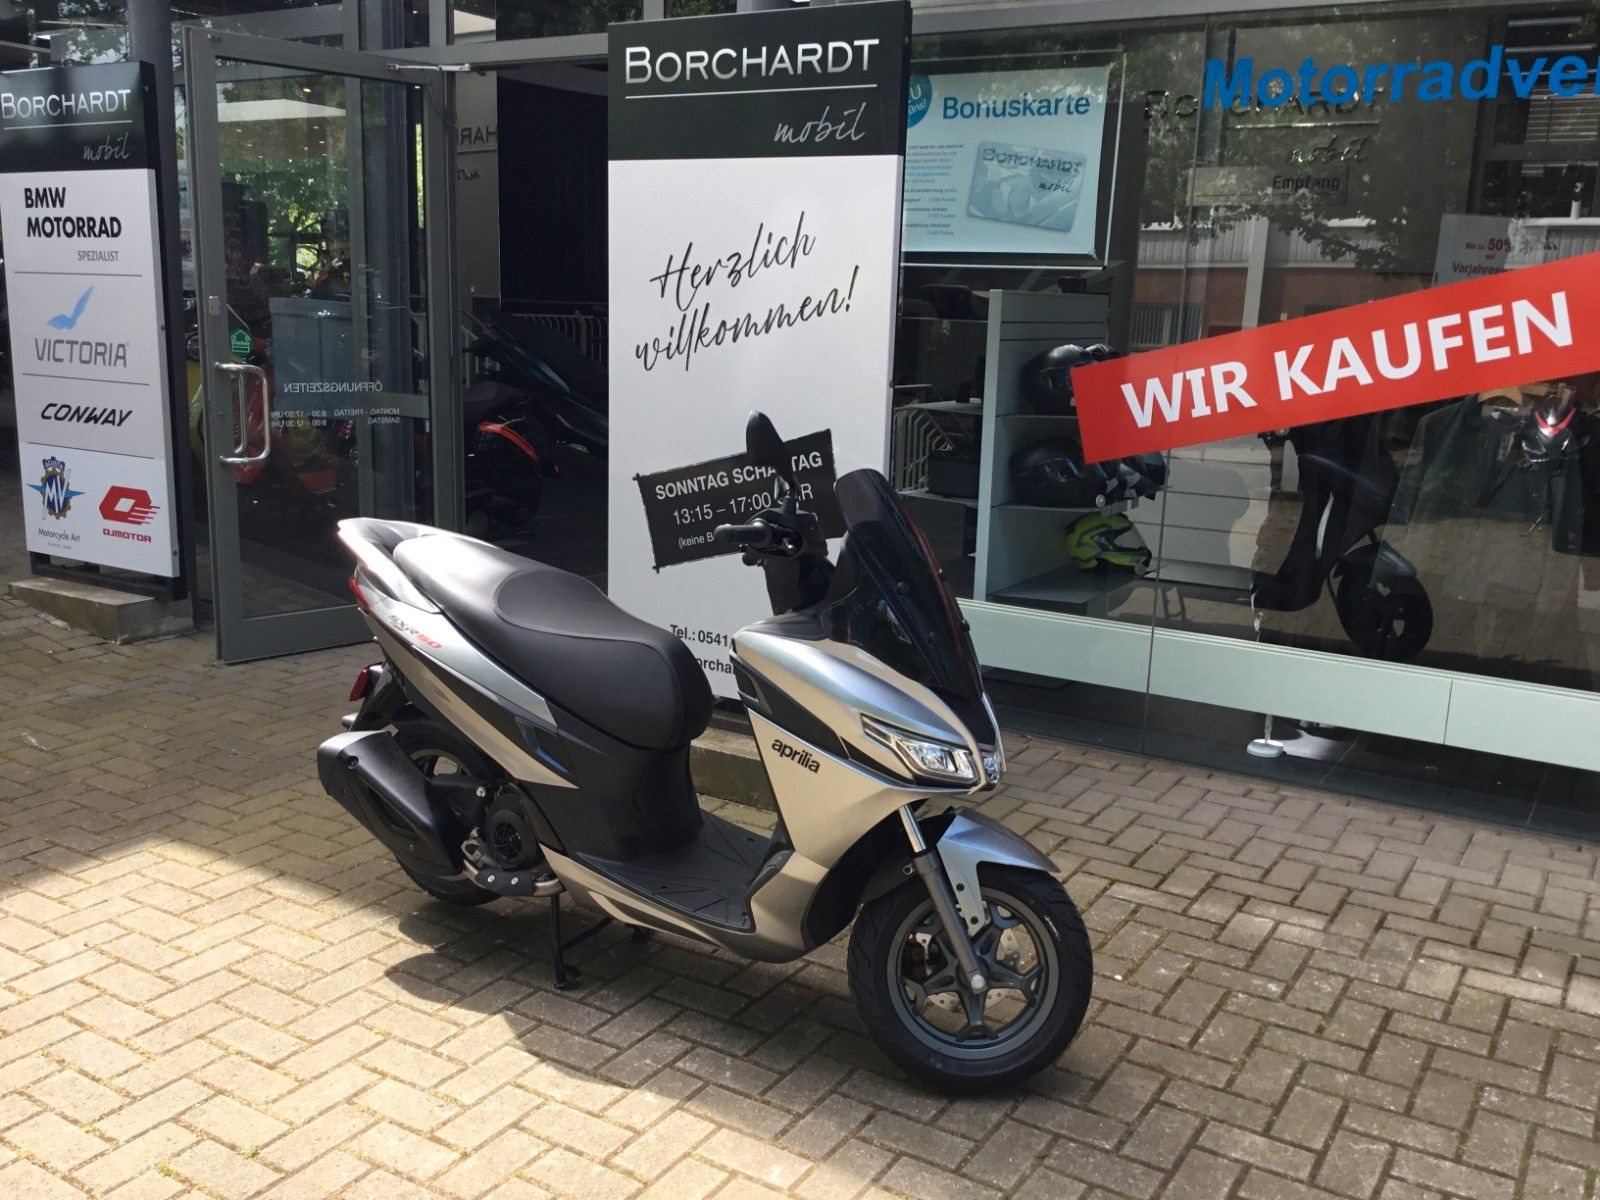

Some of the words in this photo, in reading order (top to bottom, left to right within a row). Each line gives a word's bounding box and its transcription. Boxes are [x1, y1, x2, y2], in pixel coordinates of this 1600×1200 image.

[625, 39, 879, 83] BORCHARDT
[1203, 45, 1600, 109] Motorradve
[1, 89, 131, 119] BORCHARDT
[942, 94, 1091, 119] Bonuskarte
[774, 102, 867, 143] mobil
[83, 132, 130, 161] mobil
[24, 187, 66, 208] BMW
[1272, 175, 1340, 192] Empfang
[27, 216, 122, 238] MOTORRAD
[77, 250, 119, 262] SPEZIALIST
[1487, 238, 1511, 252] 50%
[650, 211, 816, 311] Herzlich
[636, 265, 859, 371] willkommen!
[35, 338, 127, 367] VICTORIA
[1120, 361, 1258, 429] WIR
[1273, 290, 1574, 402] KAUFEN
[40, 403, 133, 427] CONWAY
[655, 472, 729, 499] SONNTAG
[733, 451, 822, 484] SCHATAG
[673, 503, 713, 525] 13:15
[729, 491, 771, 514] 17:00
[38, 527, 69, 541] Motorcycle
[679, 535, 705, 549] (keine
[670, 624, 695, 641] Tel.:
[696, 657, 732, 674] orcha
[771, 738, 821, 774] aprilia
